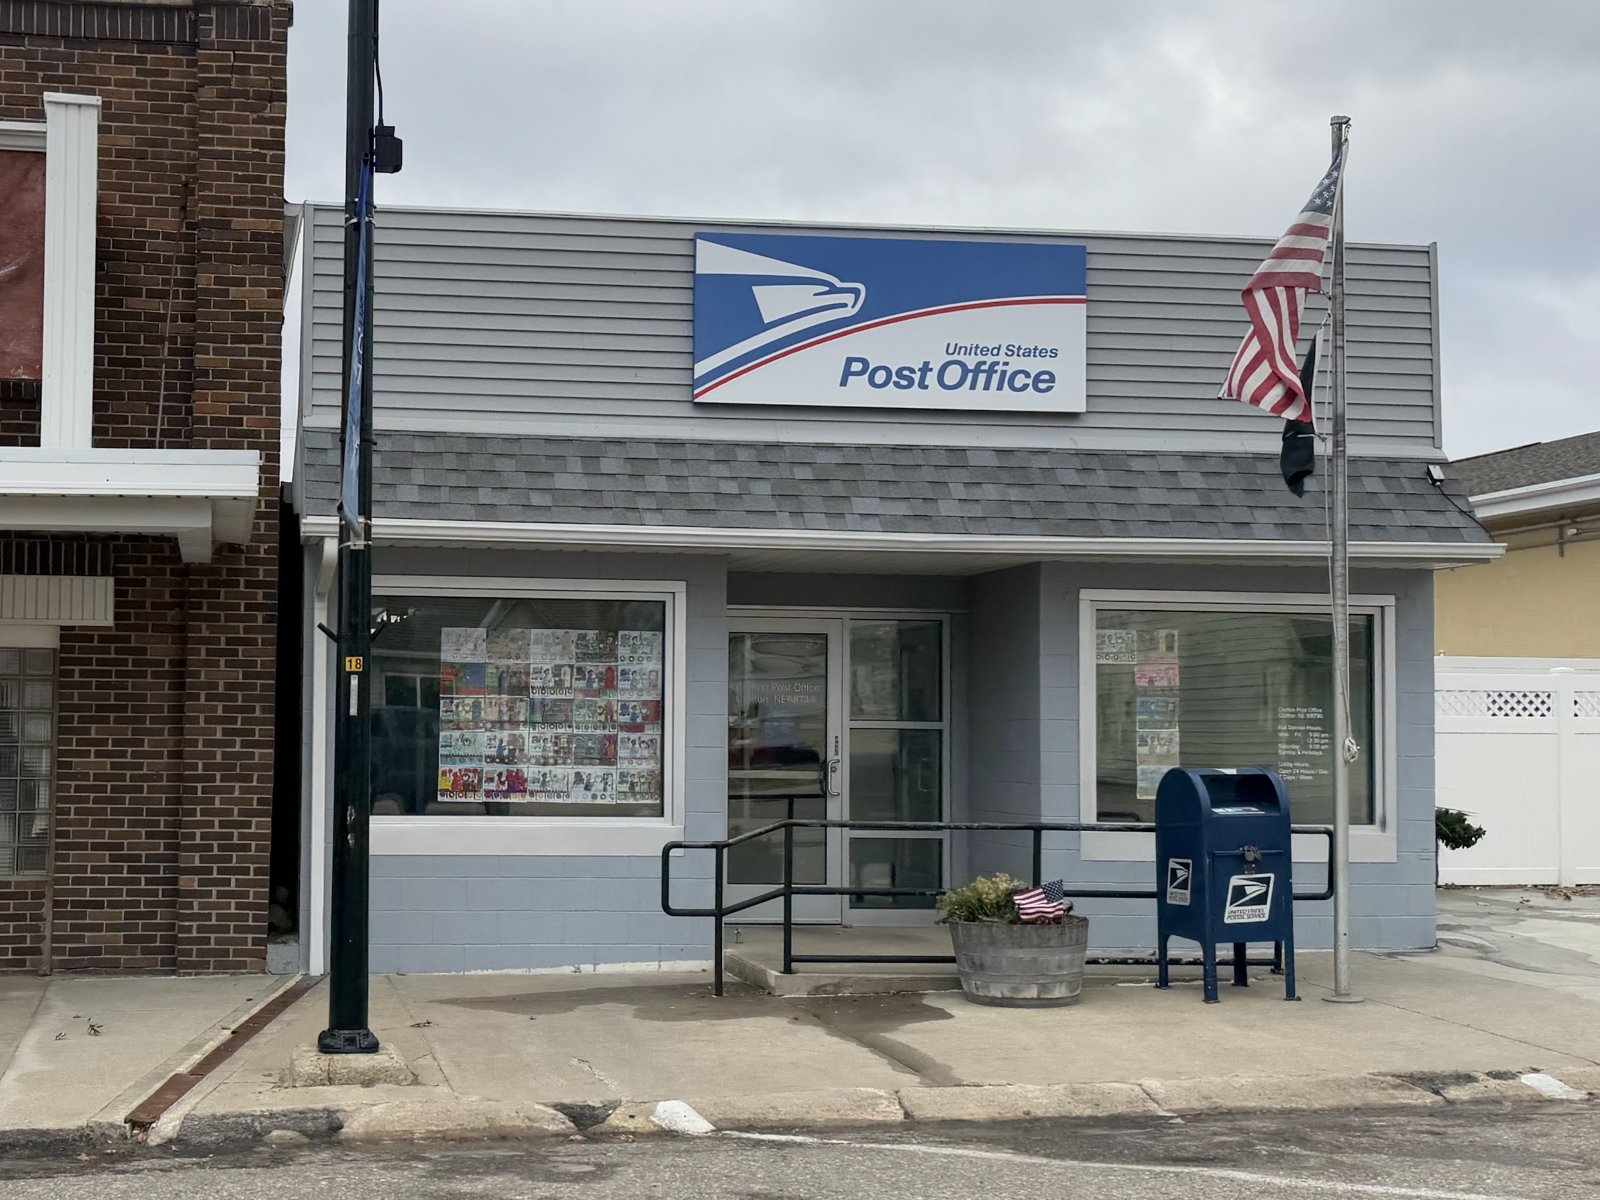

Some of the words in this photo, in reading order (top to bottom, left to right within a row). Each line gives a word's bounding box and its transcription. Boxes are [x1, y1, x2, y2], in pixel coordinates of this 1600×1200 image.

[945, 342, 1001, 357] United
[1004, 344, 1059, 359] States
[839, 356, 933, 390] Post
[937, 359, 1056, 394] Office
[347, 658, 362, 670] 18
[772, 682, 791, 692] Post
[793, 682, 820, 693] Office
